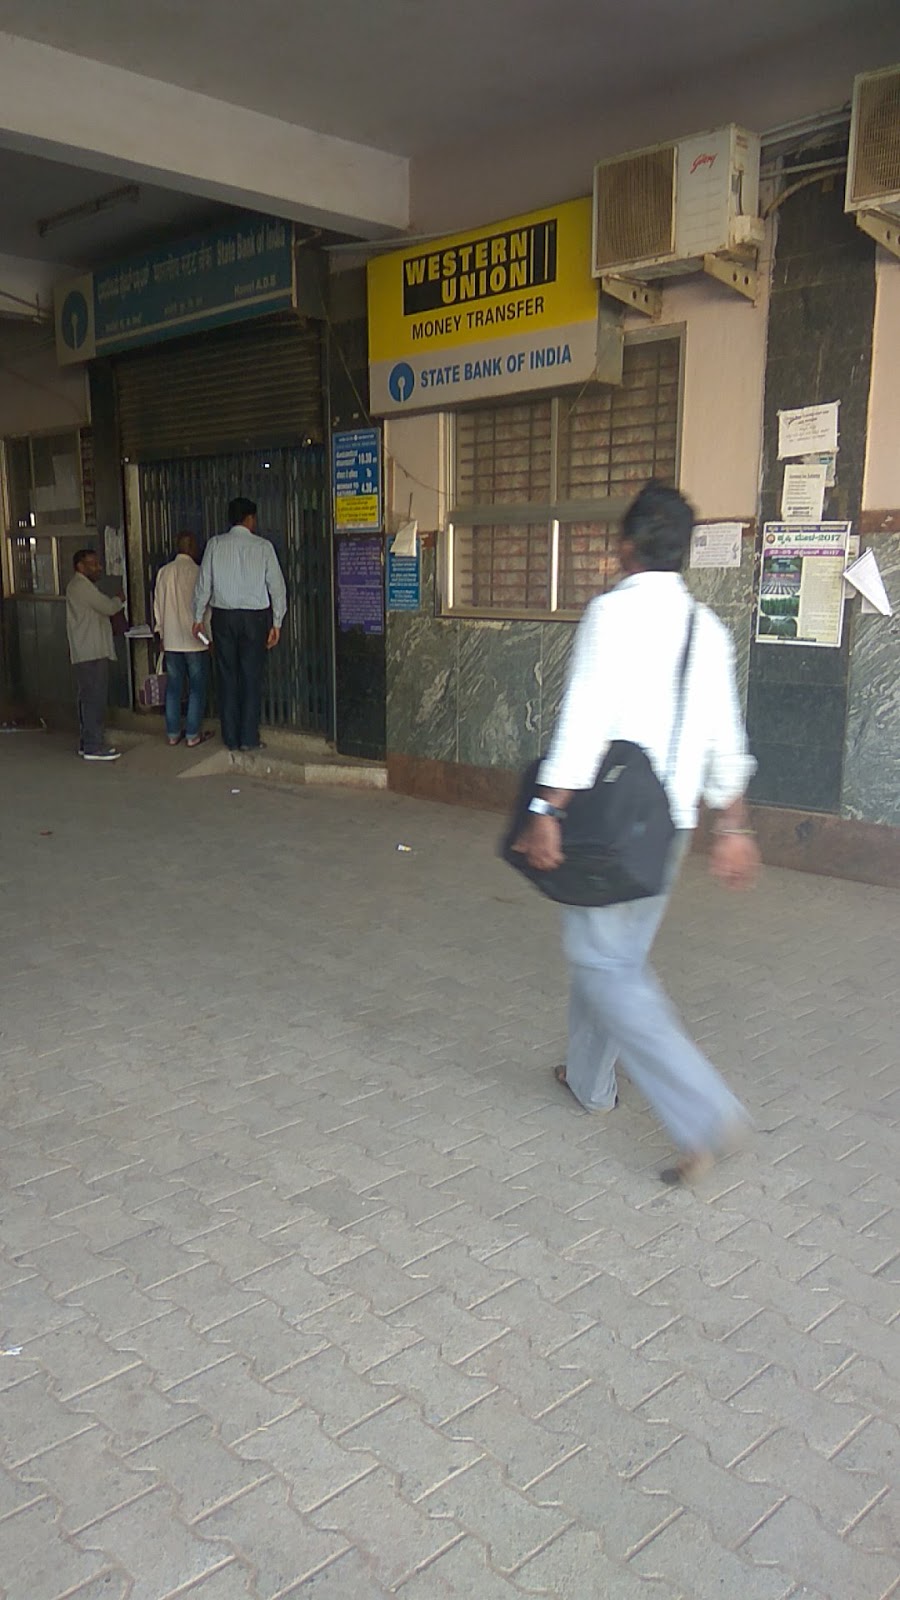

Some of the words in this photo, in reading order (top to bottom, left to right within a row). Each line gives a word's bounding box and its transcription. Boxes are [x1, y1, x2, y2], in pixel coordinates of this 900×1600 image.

[405, 230, 528, 286] WESTERN
[441, 260, 527, 304] UNION
[412, 315, 462, 340] MONEY
[467, 296, 545, 329] TRANSFER
[420, 365, 460, 388] STATE
[464, 358, 502, 381] BANK
[506, 352, 525, 373] OF
[530, 344, 572, 369] INDIA
